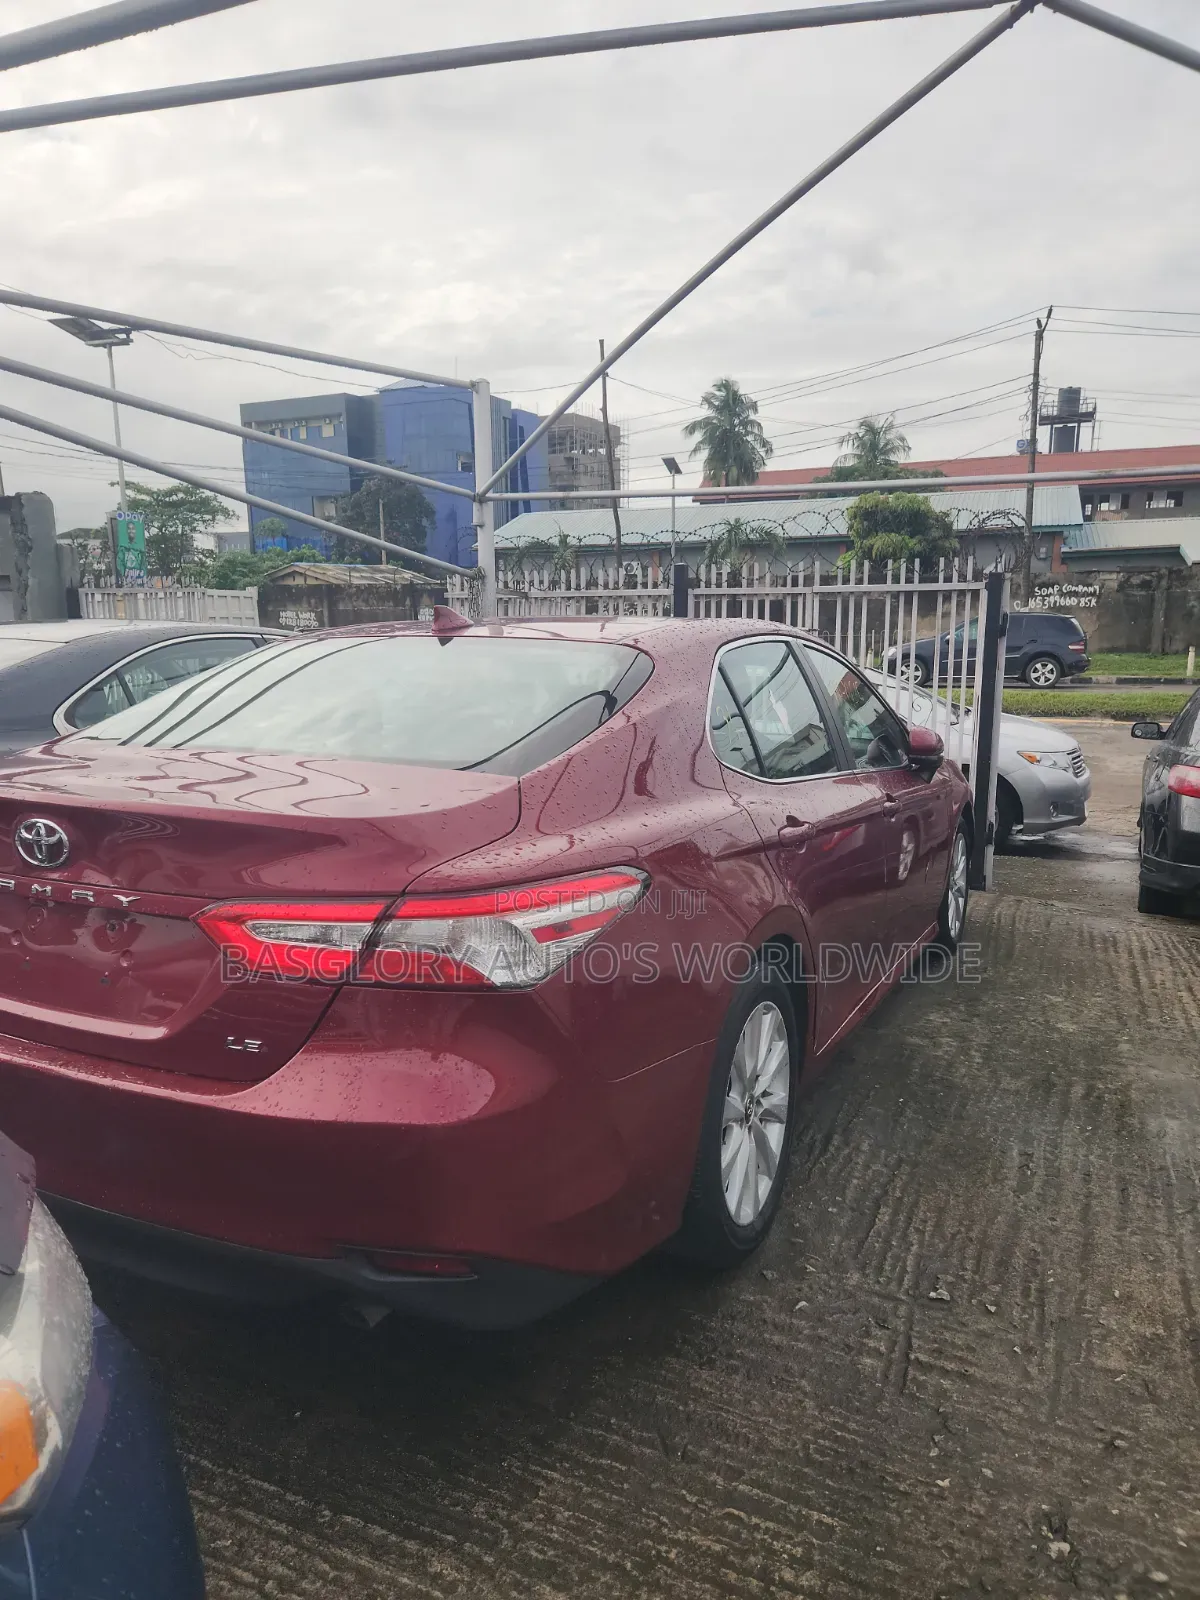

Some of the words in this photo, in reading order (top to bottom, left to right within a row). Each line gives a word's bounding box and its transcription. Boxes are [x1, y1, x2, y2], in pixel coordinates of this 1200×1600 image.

[1034, 585, 1060, 596] SOAP
[1062, 583, 1100, 595] COMPANY
[224, 1036, 263, 1053] LE
